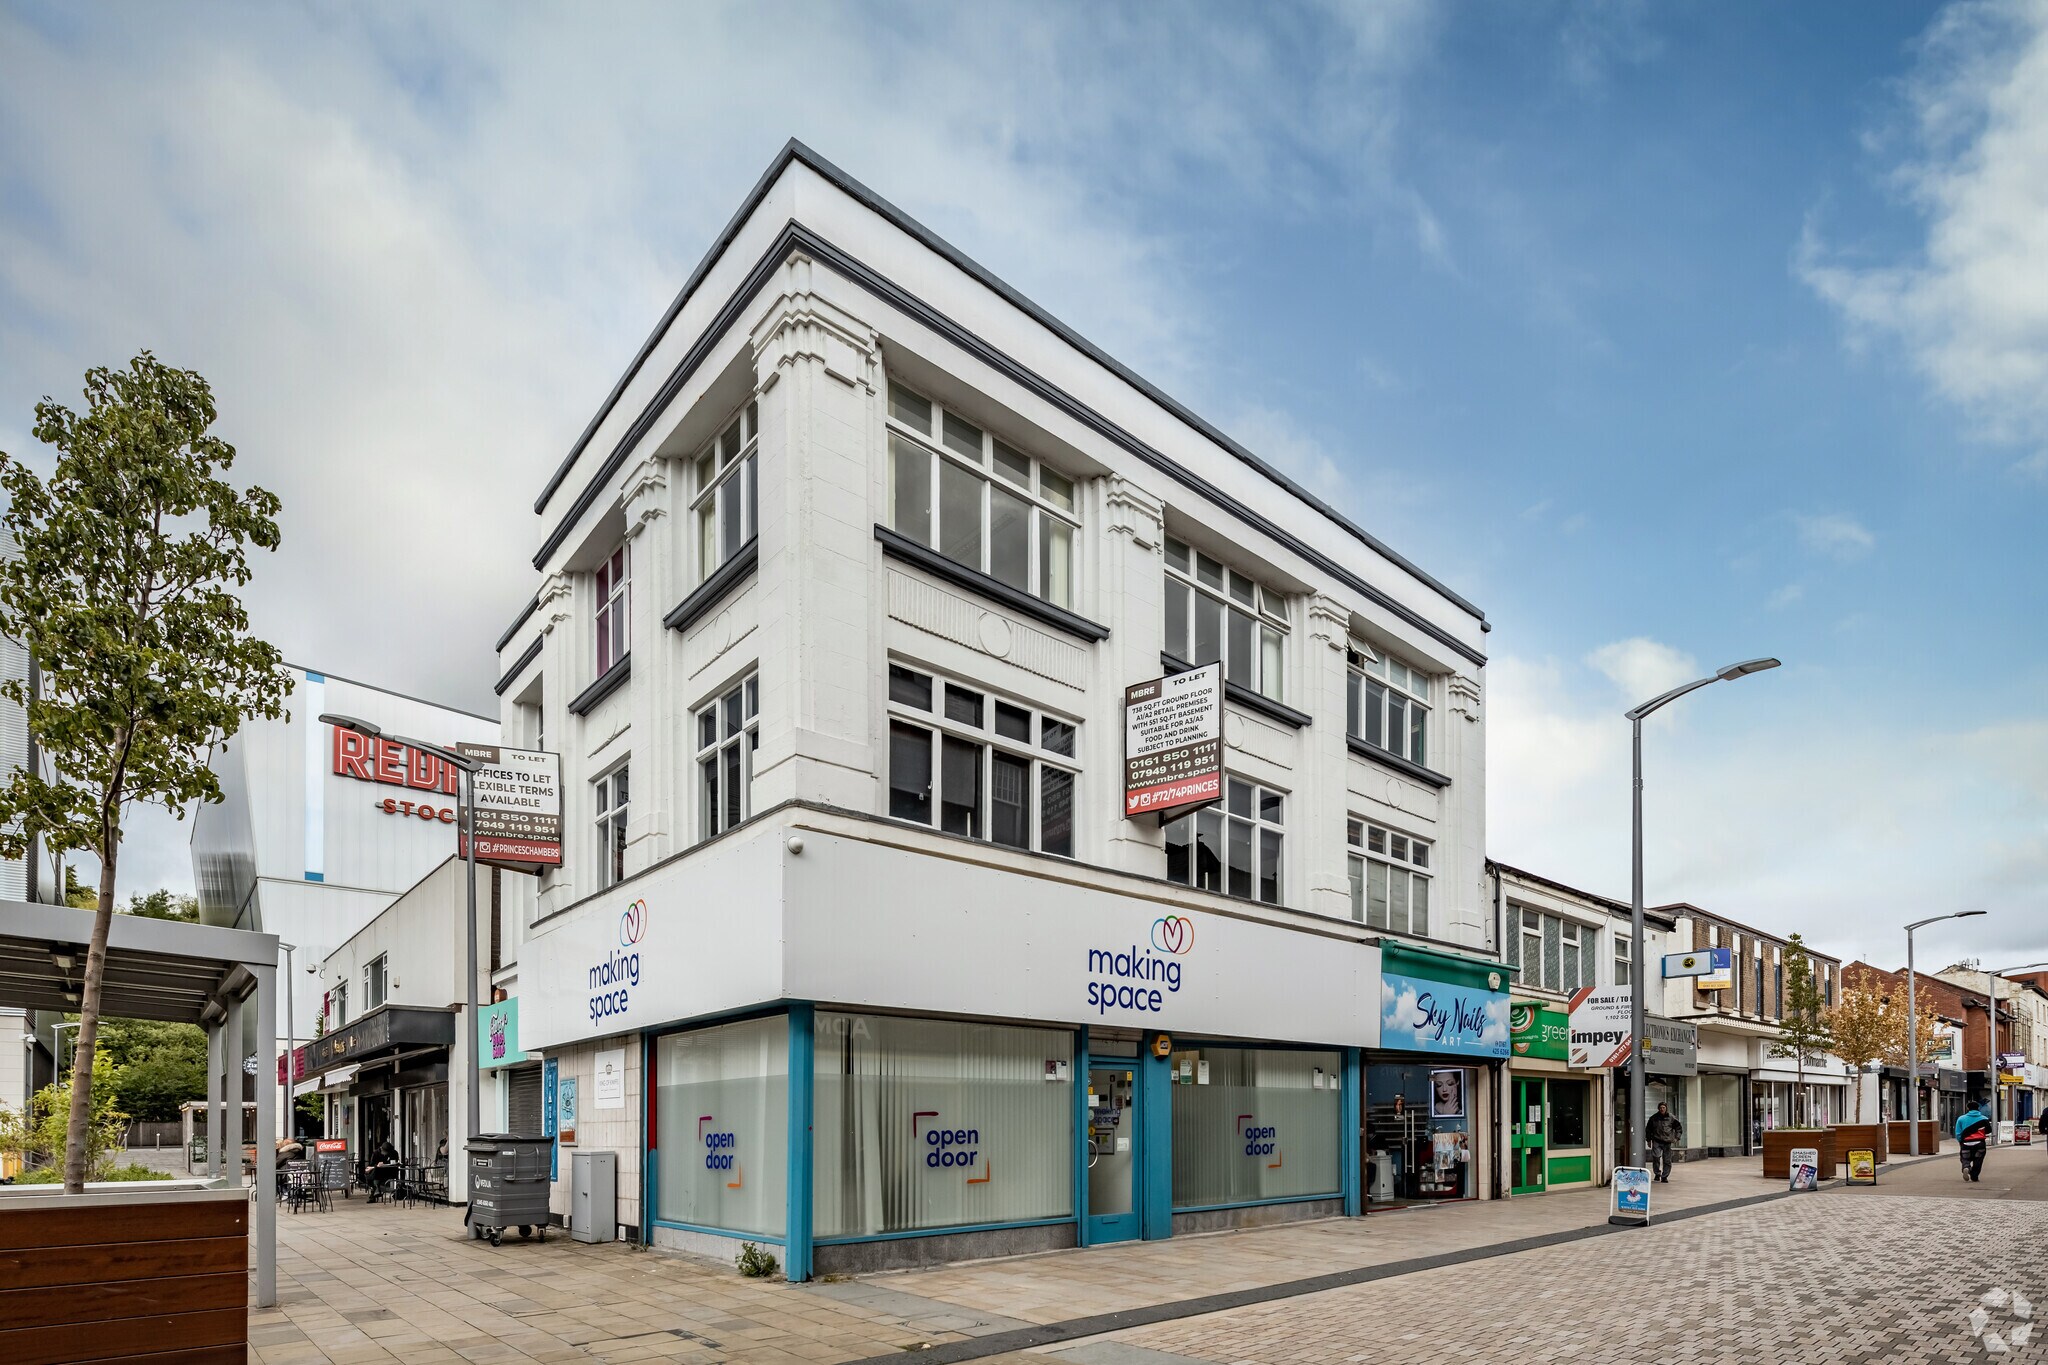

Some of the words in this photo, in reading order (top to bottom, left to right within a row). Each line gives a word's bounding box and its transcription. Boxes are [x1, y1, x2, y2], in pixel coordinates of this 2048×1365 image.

[1131, 686, 1155, 700] MBRE
[1144, 702, 1160, 711] SQ.FT
[1162, 693, 1189, 706] GROUND
[1191, 688, 1212, 698] FLOOR
[1132, 722, 1148, 730] WITH
[1149, 718, 1158, 726] 551
[1160, 713, 1176, 724] SQ.FT
[1178, 704, 1213, 718] BASEMENT
[1136, 712, 1152, 721] A1/A2
[1154, 706, 1175, 717] RETAIL
[1176, 697, 1208, 710] PREMISES
[1141, 724, 1169, 736] SUITABLE
[1171, 719, 1184, 728] FOR
[1185, 715, 1204, 725] A3/A5
[1145, 734, 1162, 744] FOOD
[1164, 730, 1178, 738] AND
[1179, 725, 1199, 735] DRINK
[1138, 741, 1164, 754] SUBJECT
[1166, 738, 1174, 746] TO
[1176, 731, 1208, 745] PLANNING
[465, 749, 492, 758] MBRE
[1130, 756, 1159, 769] 0161
[1163, 749, 1189, 762] 850
[1193, 742, 1217, 755] 1111
[1132, 766, 1167, 780] 07949
[1170, 760, 1191, 772] 119
[1194, 754, 1215, 766] 951
[516, 773, 530, 781] TO
[533, 774, 551, 784] LET
[1128, 765, 1218, 789] www.mbre.space
[474, 781, 516, 793] LEXIBLE
[519, 785, 554, 796] TERMS
[1152, 779, 1218, 803] #72/74PRINCES
[480, 794, 540, 808] AVAILABLE
[475, 820, 505, 829] 7949
[535, 826, 555, 834] 951
[501, 813, 528, 822] 850
[492, 844, 559, 857] #PRINCESCHAMBERS
[590, 949, 639, 986] making
[1089, 945, 1181, 992] making
[590, 989, 628, 1027] space
[1088, 982, 1162, 1015] space
[1413, 992, 1451, 1040] Sky
[1450, 997, 1486, 1038] Nails
[1442, 1036, 1461, 1047] ART
[1572, 1030, 1623, 1046] impey
[706, 1133, 734, 1151] open
[927, 1130, 979, 1149] open
[1245, 1127, 1275, 1142] open
[927, 1147, 977, 1168] door
[1245, 1141, 1275, 1155] door
[706, 1150, 733, 1169] door
